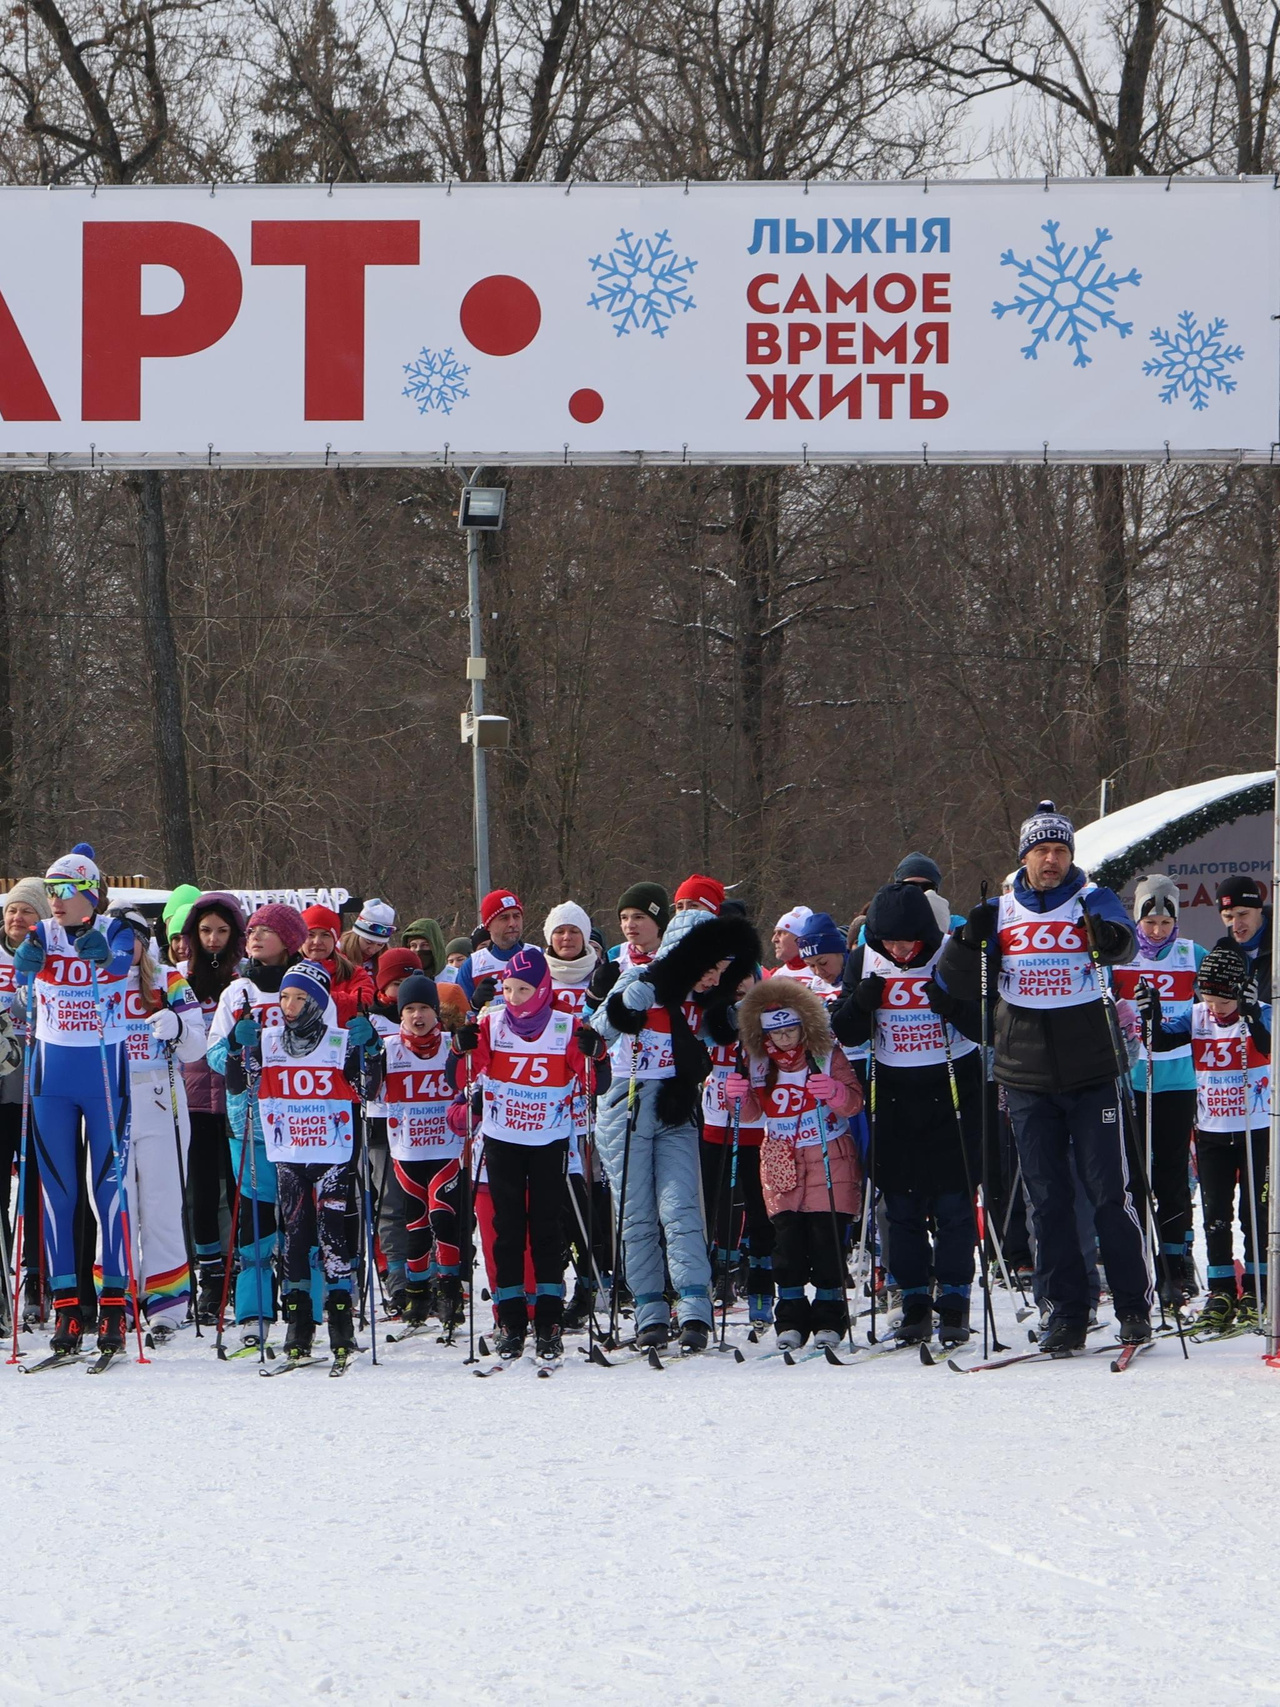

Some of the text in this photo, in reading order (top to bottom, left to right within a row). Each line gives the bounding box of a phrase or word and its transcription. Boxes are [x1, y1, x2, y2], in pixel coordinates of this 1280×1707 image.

[746, 217, 951, 256] ЛЫЖНЯ
[746, 272, 952, 314] САМОЕ
[745, 321, 950, 365] ВРЕМЯ
[744, 373, 950, 421] ЖИТЬ
[1029, 829, 1070, 845] SOCHI
[1167, 860, 1273, 876] БЛАГОТВОРИ
[1009, 925, 1082, 951] 366
[1019, 968, 1071, 977] САМОЕ
[1019, 977, 1072, 987] ВРЕМЯ
[1094, 961, 1110, 1005] NORDWAY
[888, 981, 930, 1006] 69
[1018, 986, 1072, 996] ЖИТЬ
[58, 1010, 97, 1020] ВРЕМЯ
[58, 1021, 98, 1032] ЖИТЬ
[890, 1022, 942, 1032] САМОЕ
[892, 1031, 943, 1042] ВРЕМЯ
[893, 1040, 945, 1052] ЖИТЬ
[508, 1056, 549, 1084] 75
[278, 1070, 334, 1096] 103
[402, 1074, 454, 1099] 148
[505, 1099, 547, 1112] САМОЕ
[771, 1087, 804, 1114] 93
[288, 1116, 327, 1125] САМОЕ
[505, 1109, 546, 1121] ВРЕМЯ
[409, 1117, 446, 1126] САМОЕ
[504, 1119, 544, 1131] ЖИТЬ
[289, 1126, 327, 1135] ВРЕМЯ
[409, 1126, 446, 1136] ВРЕМЯ
[290, 1136, 327, 1147] ЖИТЬ
[410, 1136, 446, 1147] ЖИТЬ
